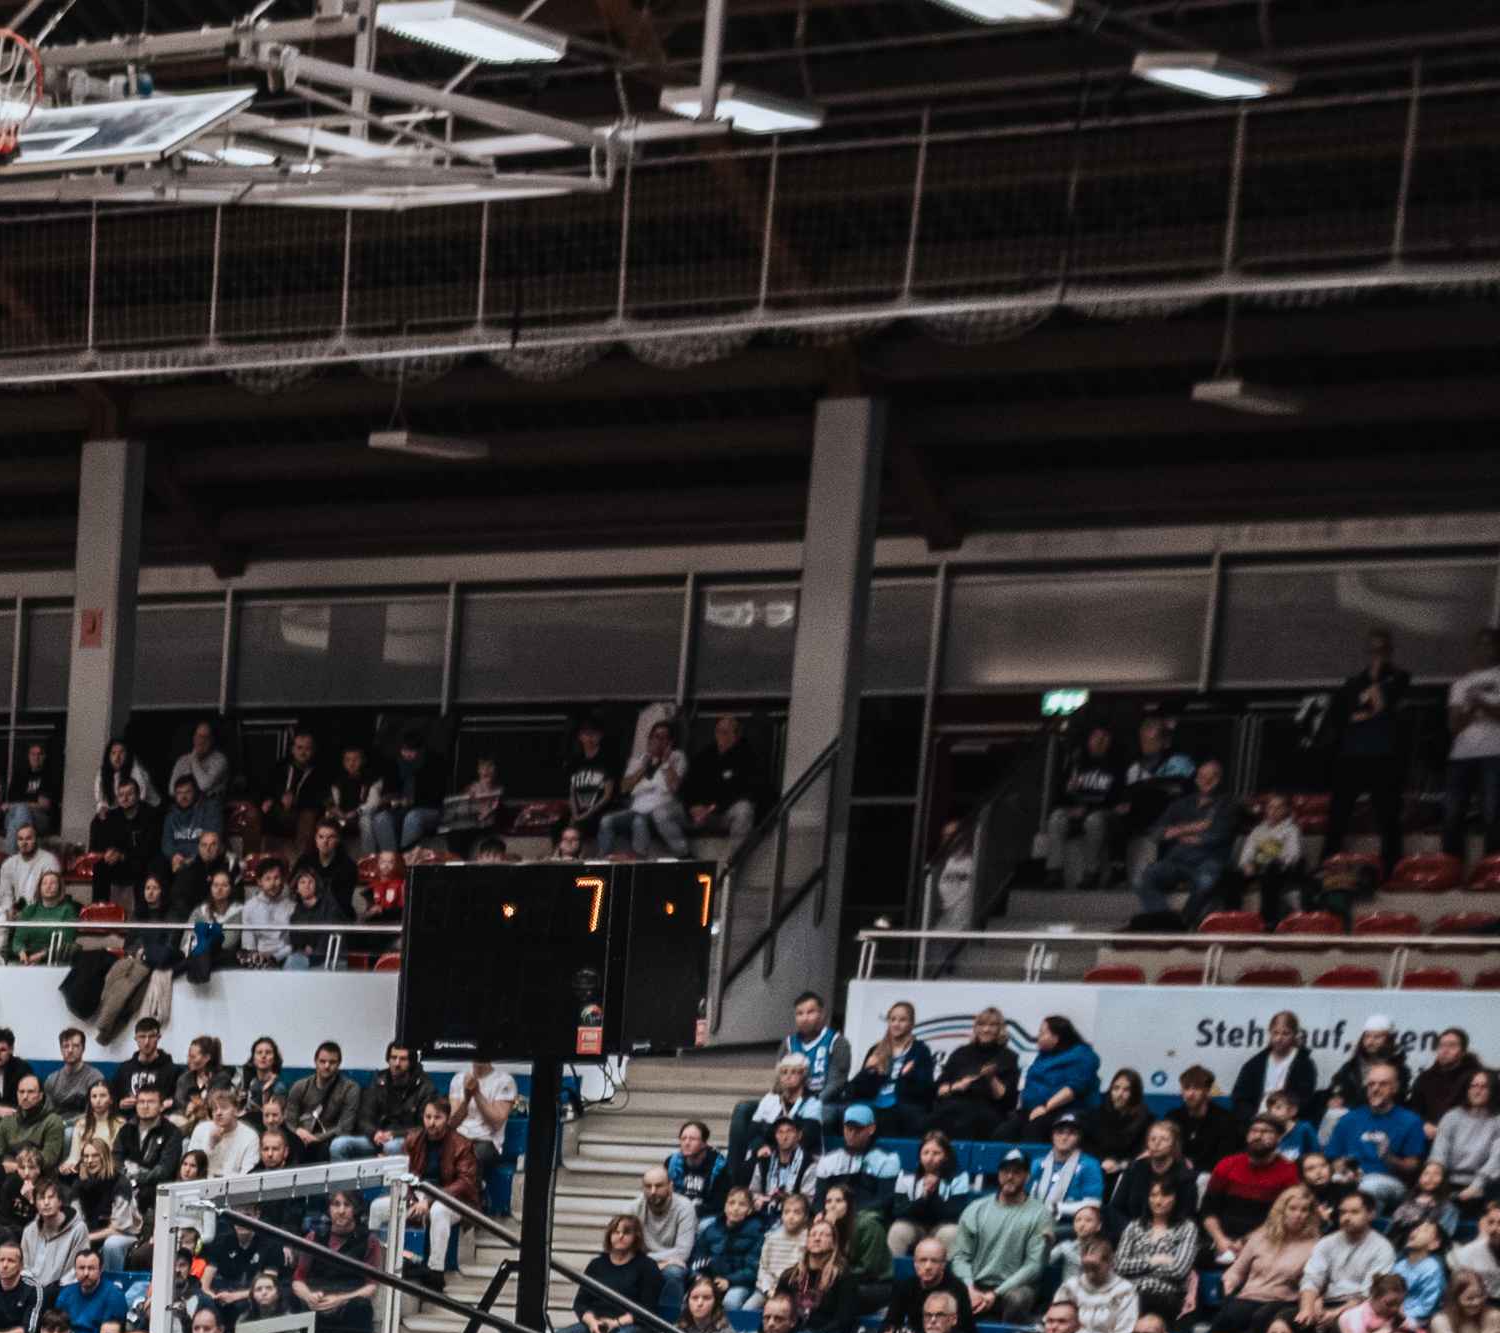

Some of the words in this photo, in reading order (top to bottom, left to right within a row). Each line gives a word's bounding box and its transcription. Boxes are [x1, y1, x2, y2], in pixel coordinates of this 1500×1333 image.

[575, 875, 604, 933] 7
[697, 873, 712, 928] 7
[1195, 1018, 1271, 1048] Steh
